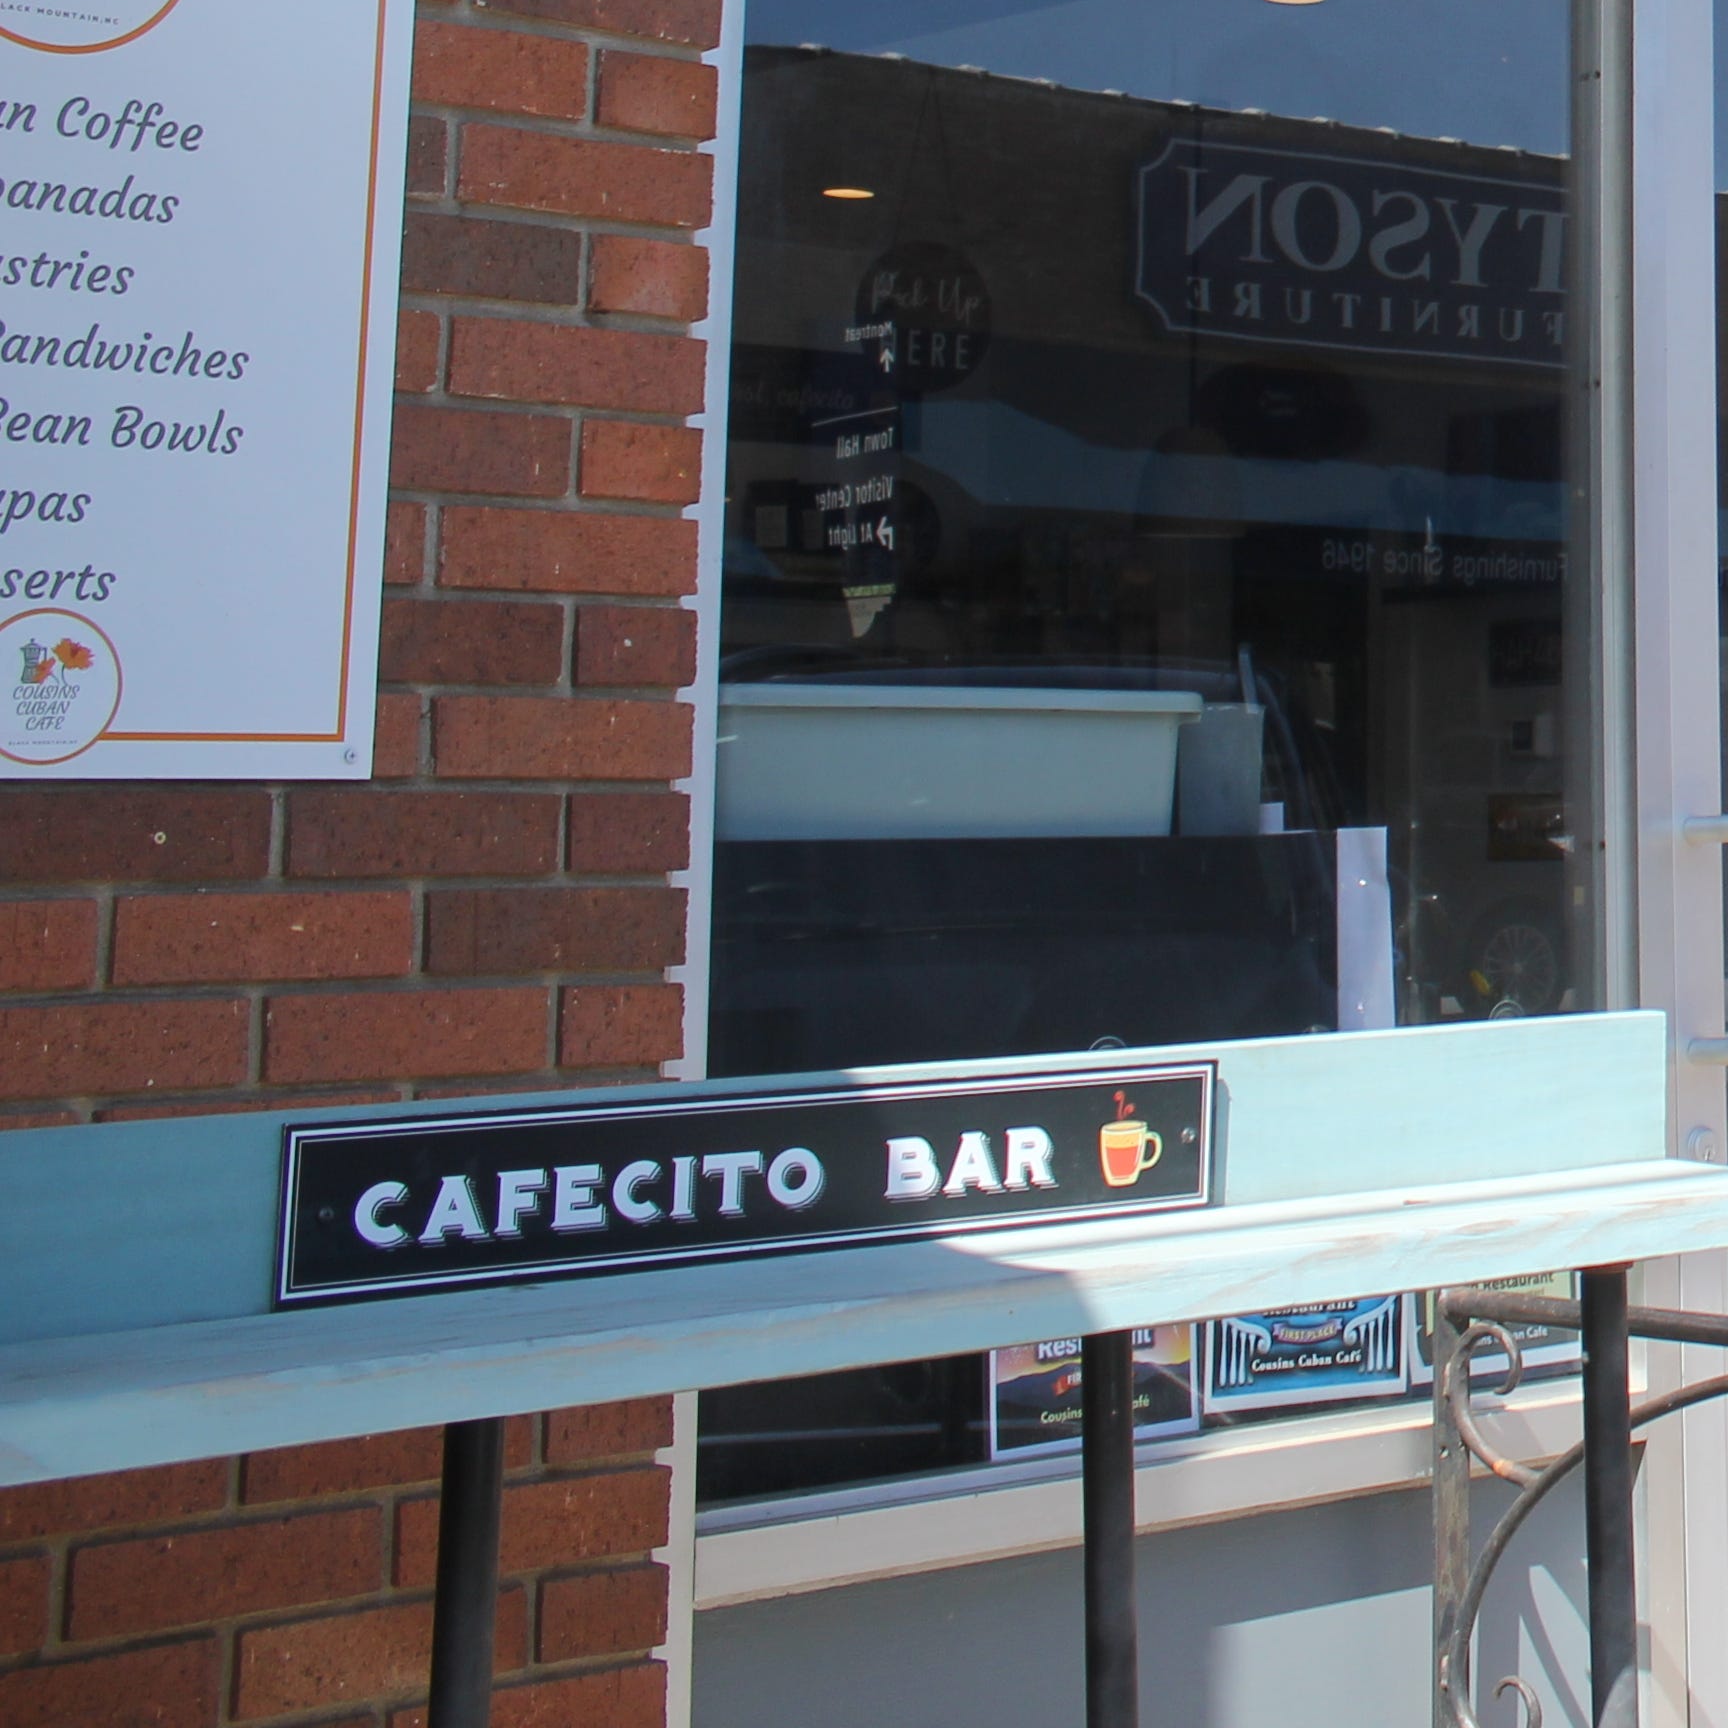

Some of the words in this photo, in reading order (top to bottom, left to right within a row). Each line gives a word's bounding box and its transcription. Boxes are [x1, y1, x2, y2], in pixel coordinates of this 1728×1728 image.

[56, 96, 204, 152] Coffee
[0, 174, 180, 224] anadas
[0, 250, 135, 295] stries
[111, 405, 244, 455] Bowls
[12, 684, 81, 700] COUSINS
[15, 700, 71, 716] CUBAN
[25, 716, 65, 731] CAFE
[354, 1147, 826, 1250] CAFECITO
[884, 1126, 1055, 1201] BAR
[1252, 1356, 1295, 1372] Cousins
[1298, 1353, 1332, 1368] Cuban
[1132, 1393, 1150, 1410] afé
